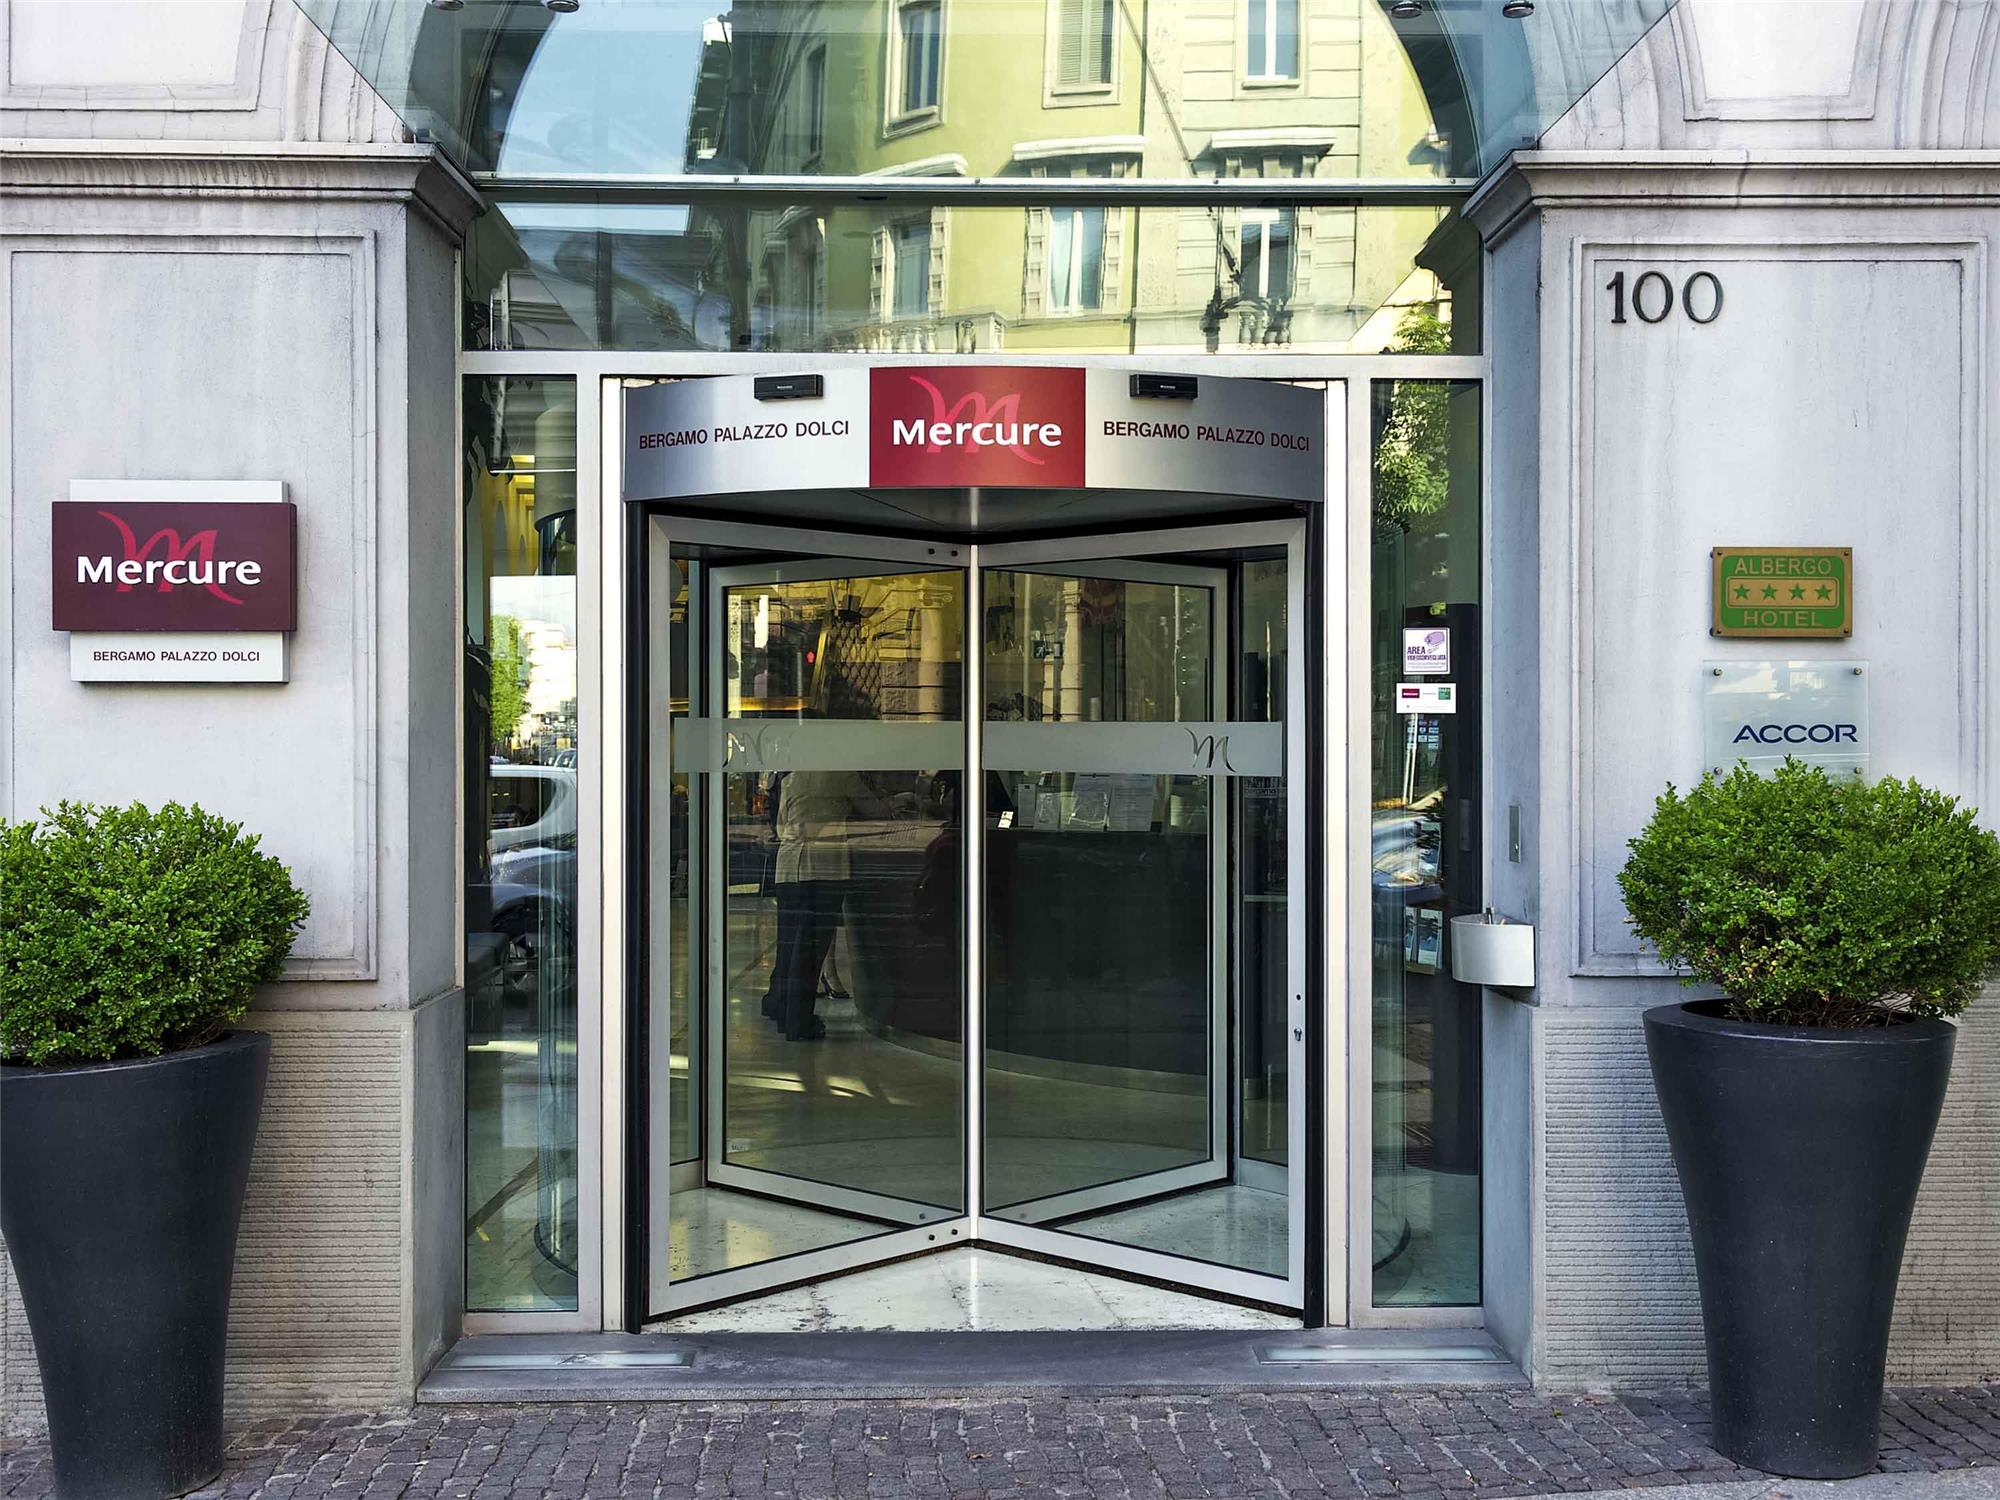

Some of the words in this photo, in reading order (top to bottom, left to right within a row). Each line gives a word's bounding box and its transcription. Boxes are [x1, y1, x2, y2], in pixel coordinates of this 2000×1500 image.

[1606, 270, 1724, 324] 100
[639, 429, 708, 450] BERGAMO
[714, 423, 788, 442] PALAZZO
[795, 420, 849, 437] DOLCI
[892, 418, 1062, 447] Mercure
[1103, 420, 1190, 440] BERGAMO
[1196, 425, 1265, 446] PALAZZO
[1270, 432, 1310, 452] DOLCI
[76, 555, 262, 586] Mercure
[1734, 557, 1832, 576] ALBERGO
[1743, 610, 1825, 627] HOTEL
[93, 650, 156, 662] BERGAMO
[160, 650, 217, 662] PALAZZO
[222, 650, 260, 662] DOLCI
[1407, 646, 1426, 655] AREA
[1732, 724, 1859, 744] ACCOR
